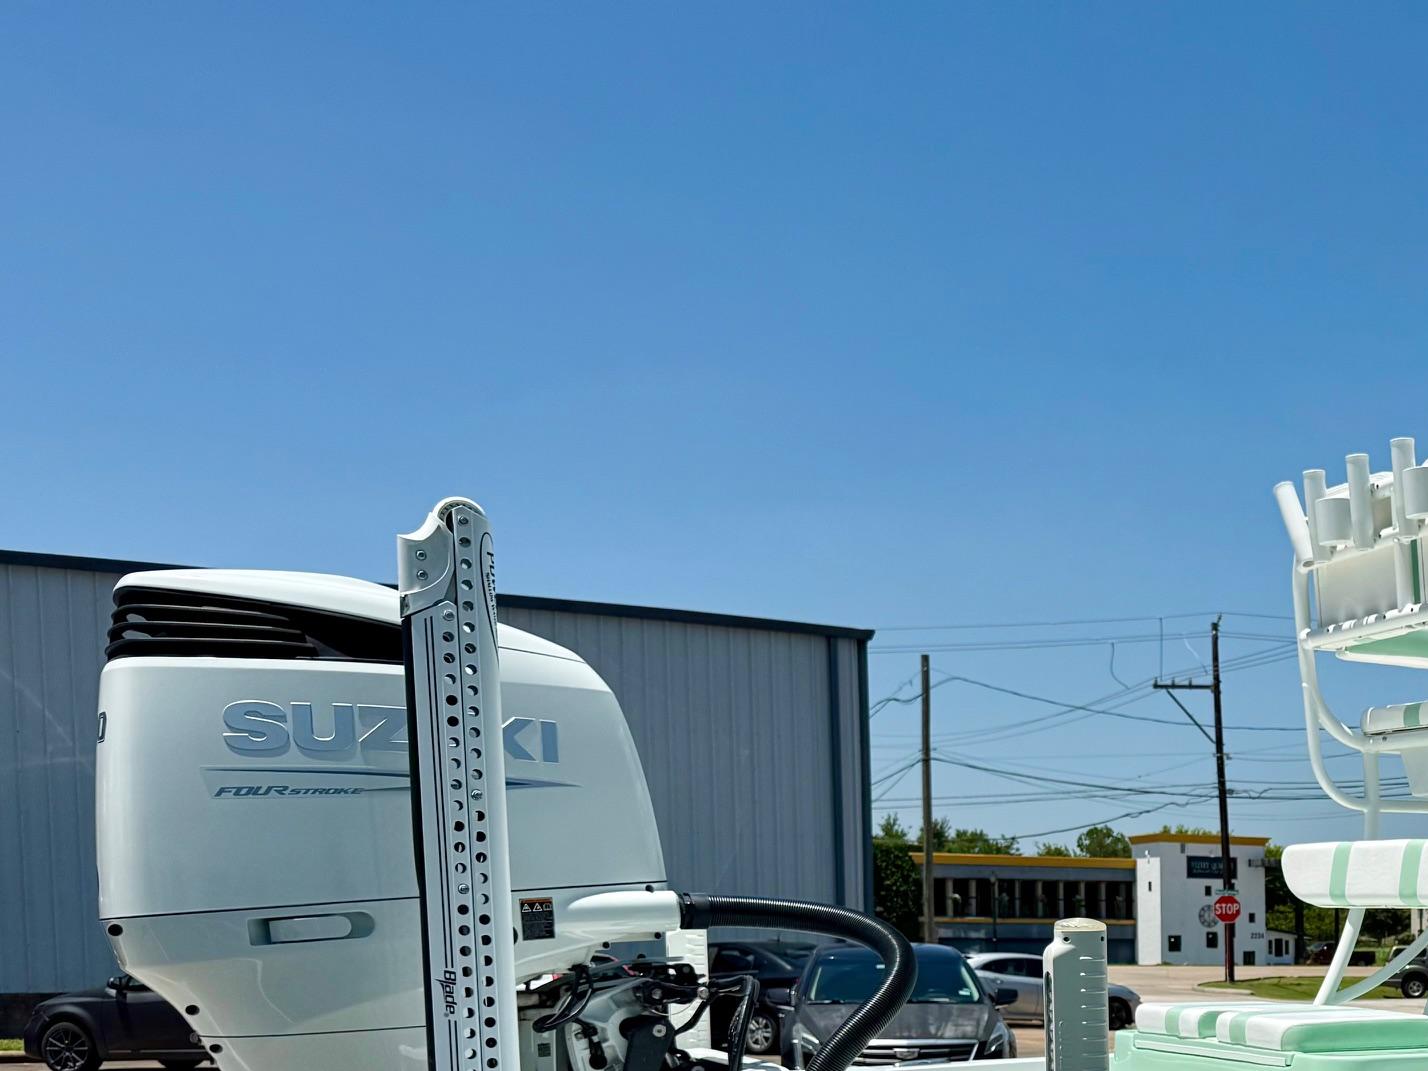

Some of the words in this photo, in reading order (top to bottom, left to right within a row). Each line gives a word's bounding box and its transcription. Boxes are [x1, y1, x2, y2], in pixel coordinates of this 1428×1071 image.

[222, 699, 560, 763] SUZKI
[1215, 903, 1240, 915] STOP
[437, 970, 457, 1015] Blade
